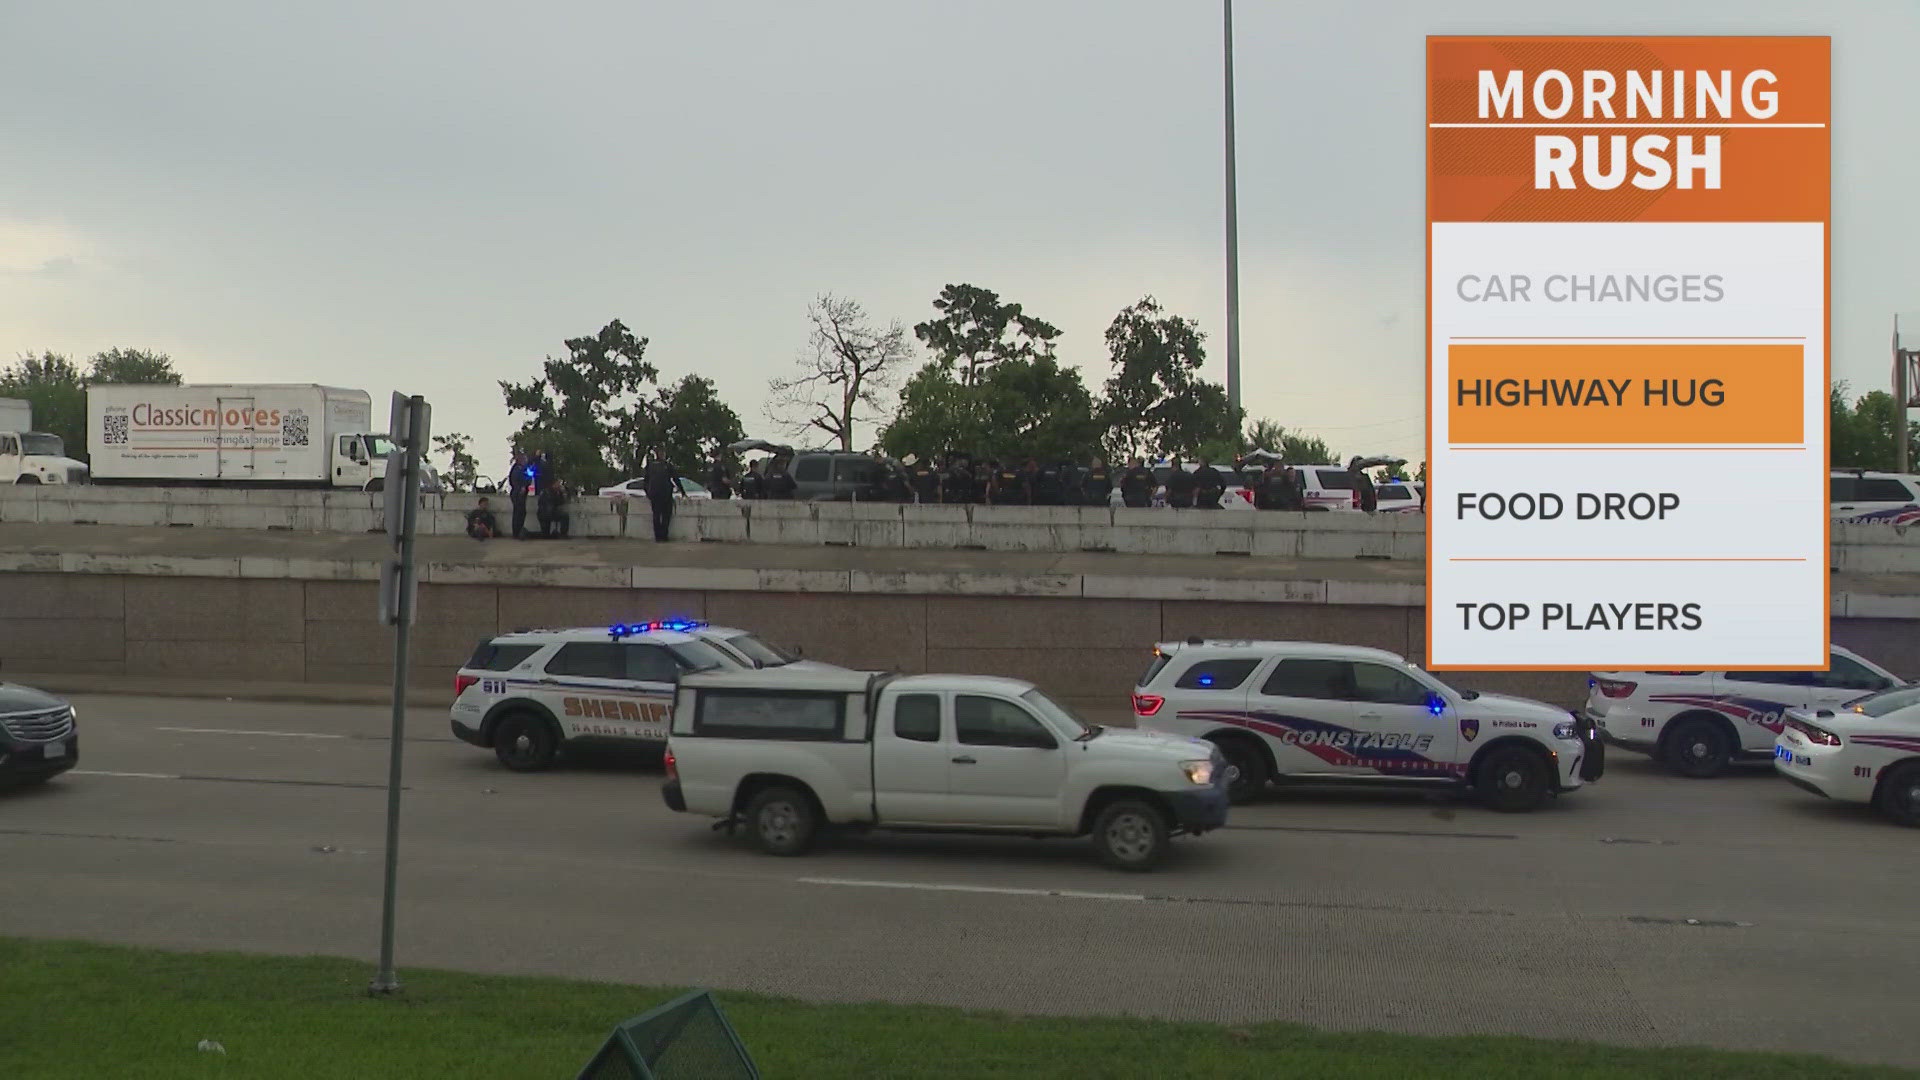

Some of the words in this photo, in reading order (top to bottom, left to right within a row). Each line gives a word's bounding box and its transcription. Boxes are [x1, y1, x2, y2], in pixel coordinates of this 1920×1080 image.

[132, 403, 280, 426] Classicmoves
[571, 723, 628, 736] HARRIS
[634, 727, 668, 738] COU
[1281, 730, 1435, 751] CONSTABLE
